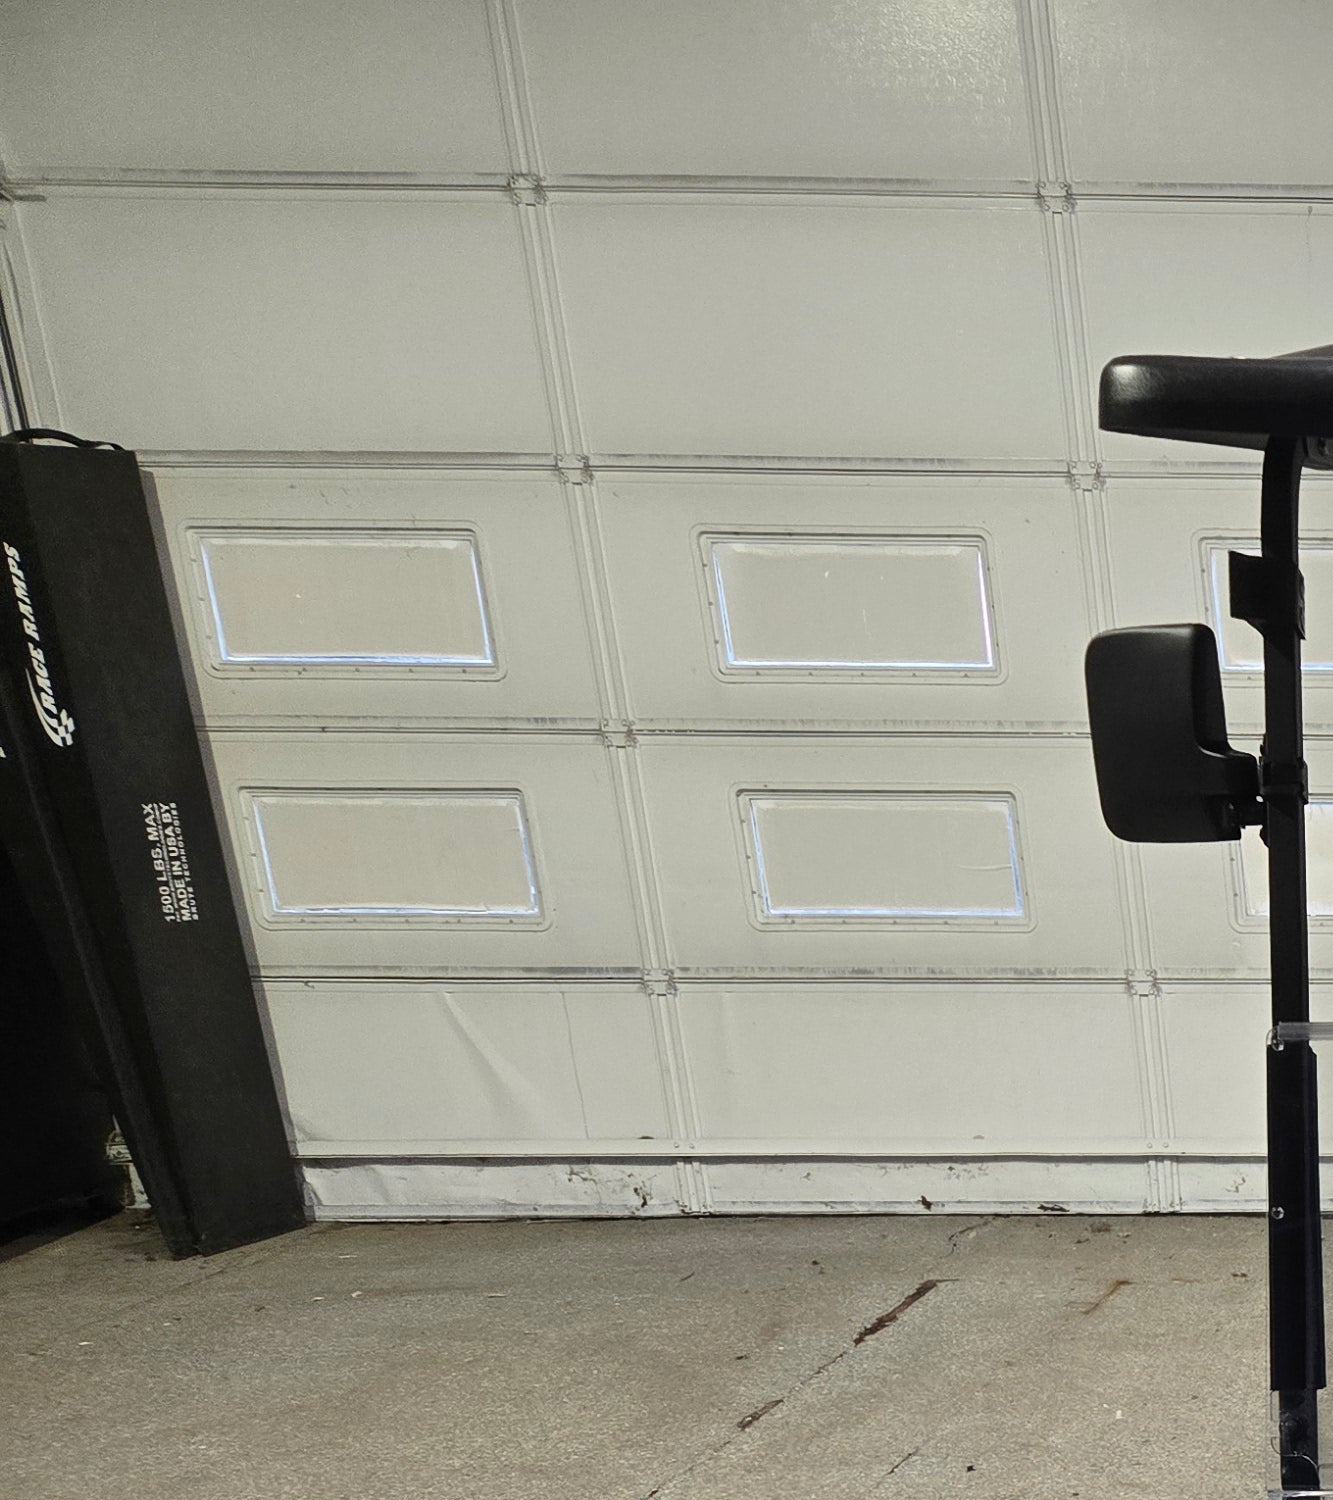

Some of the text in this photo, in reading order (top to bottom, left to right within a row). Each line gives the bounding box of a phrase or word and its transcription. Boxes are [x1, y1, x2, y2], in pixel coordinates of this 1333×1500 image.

[3, 541, 58, 714] RACE RAMPS
[141, 803, 160, 841] MAX
[159, 802, 173, 824] BY
[164, 826, 179, 857] USA
[170, 802, 199, 920] BRUTE TECHNOLOGIES
[171, 861, 182, 876] IN
[159, 886, 176, 922] 1500
[176, 878, 192, 922] MADE
